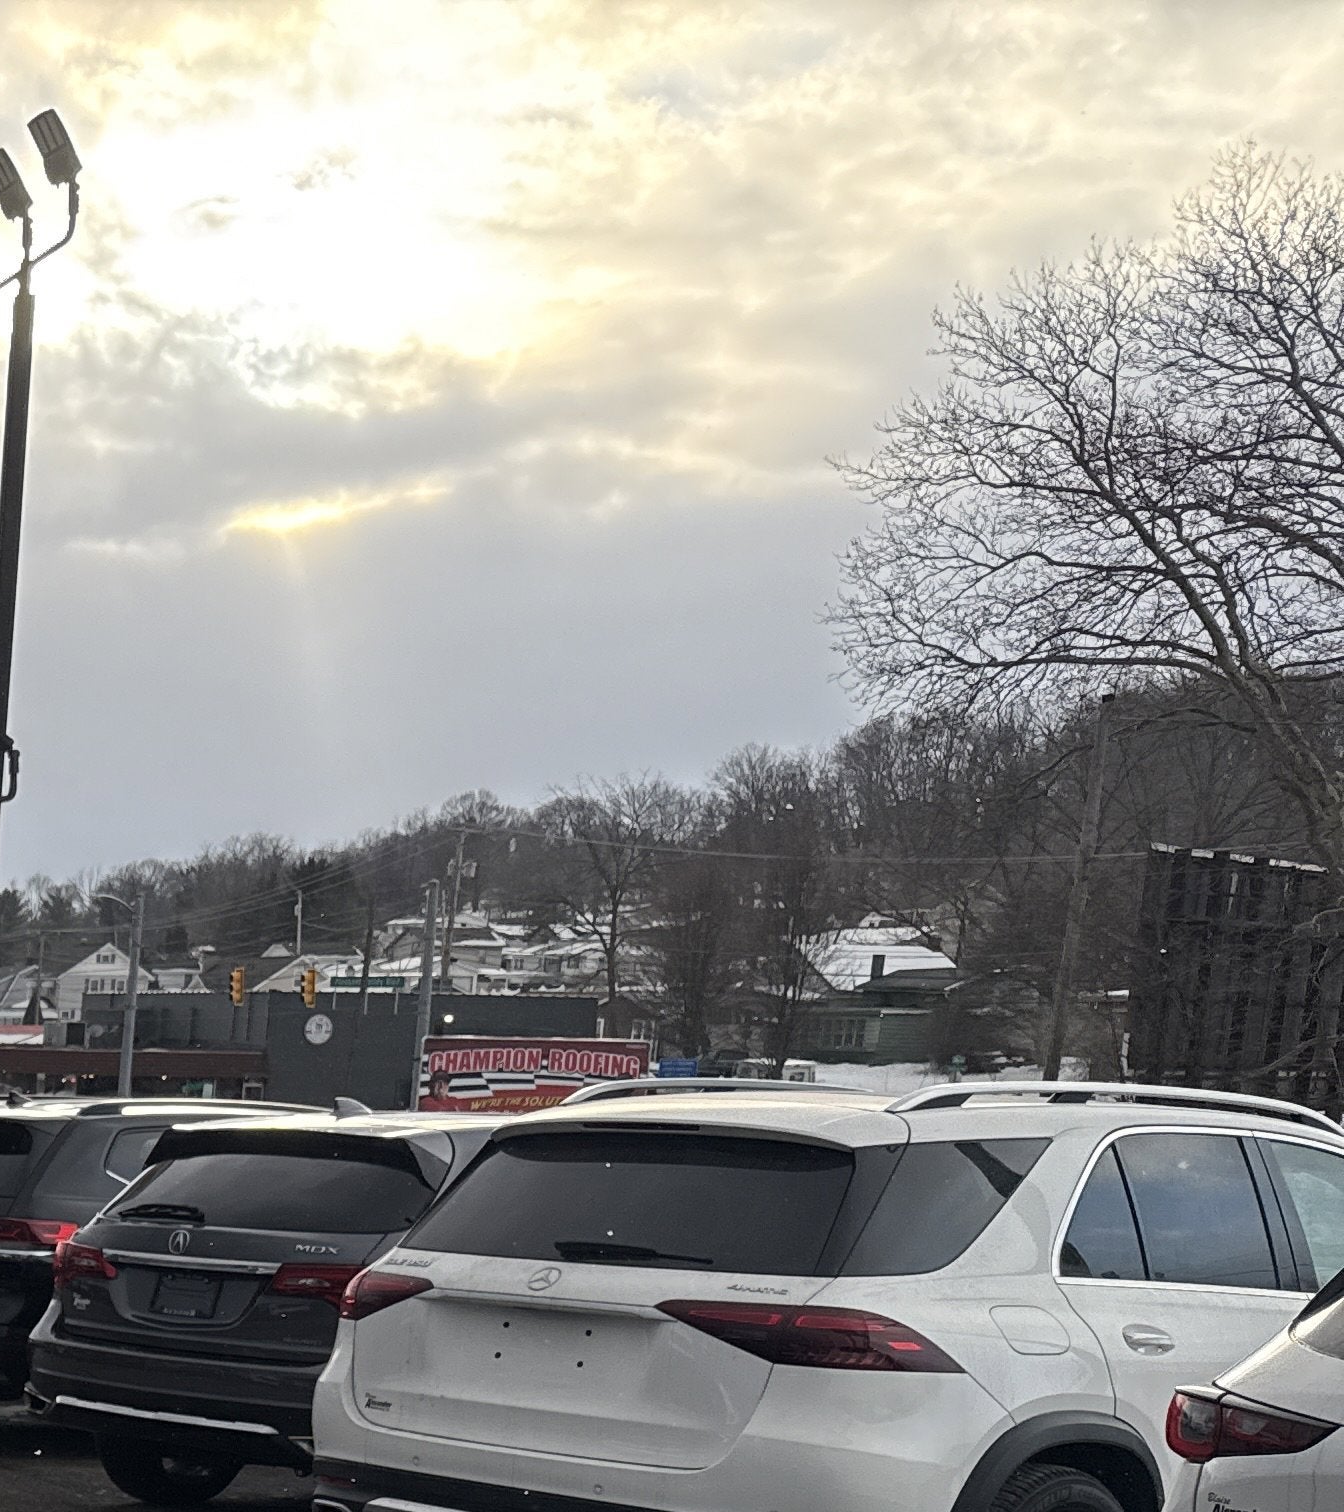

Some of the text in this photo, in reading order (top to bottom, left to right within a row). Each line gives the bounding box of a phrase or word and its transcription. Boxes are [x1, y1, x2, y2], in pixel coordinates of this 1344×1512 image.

[428, 1048, 543, 1074] CHAMPION
[548, 1049, 641, 1079] ROOFING
[295, 1244, 341, 1255] MDX
